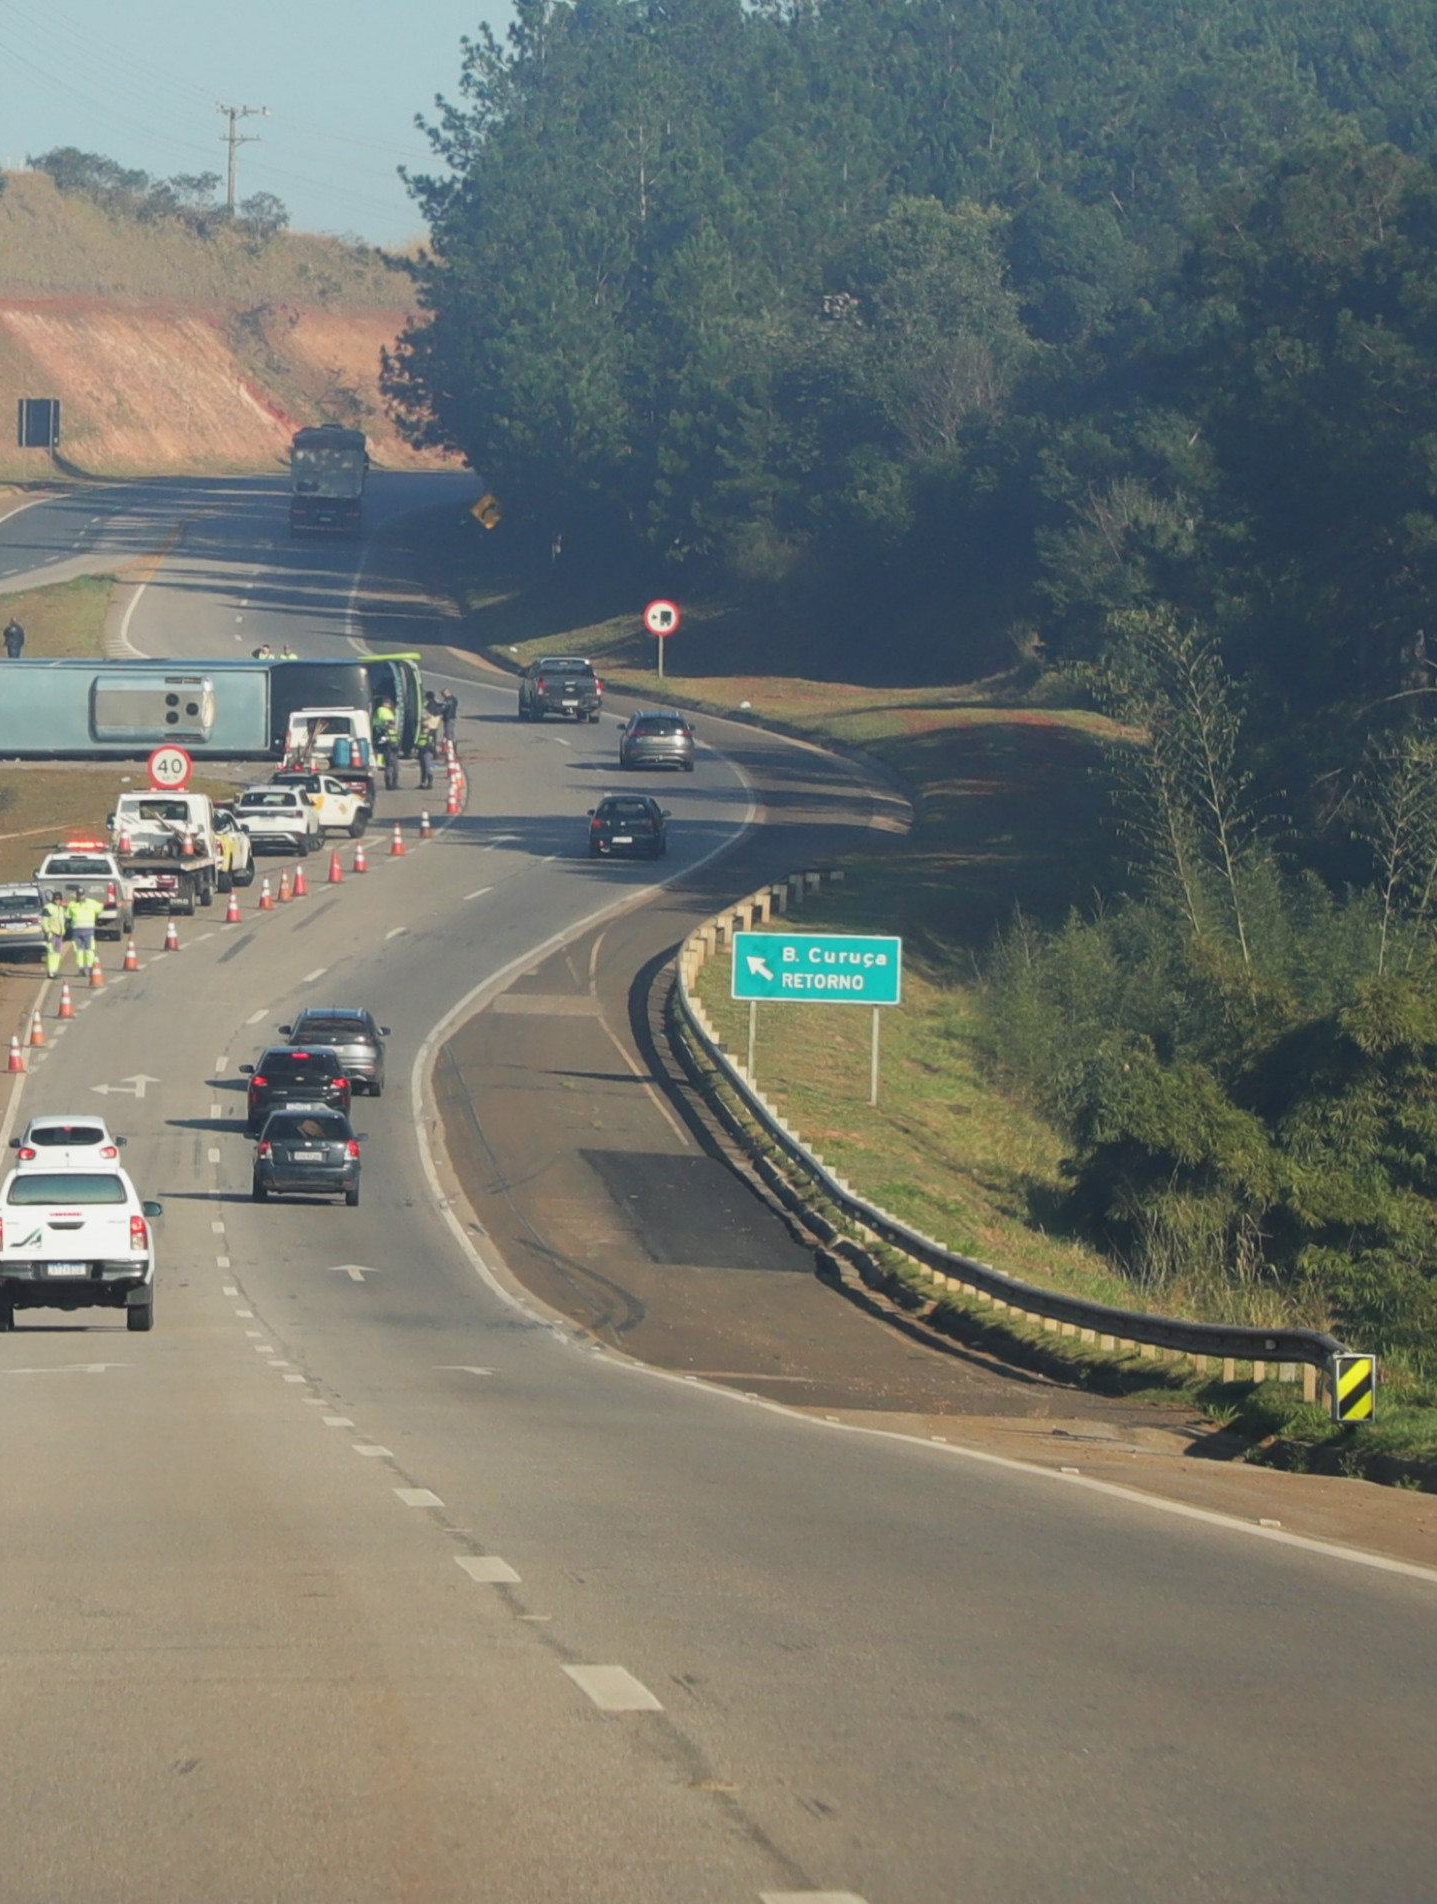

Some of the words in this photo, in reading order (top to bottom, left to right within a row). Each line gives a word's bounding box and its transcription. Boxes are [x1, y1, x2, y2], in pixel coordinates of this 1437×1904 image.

[157, 758, 182, 774] 40
[782, 947, 800, 962] B.
[808, 948, 887, 968] Curuça
[782, 973, 864, 990] RETORNO
